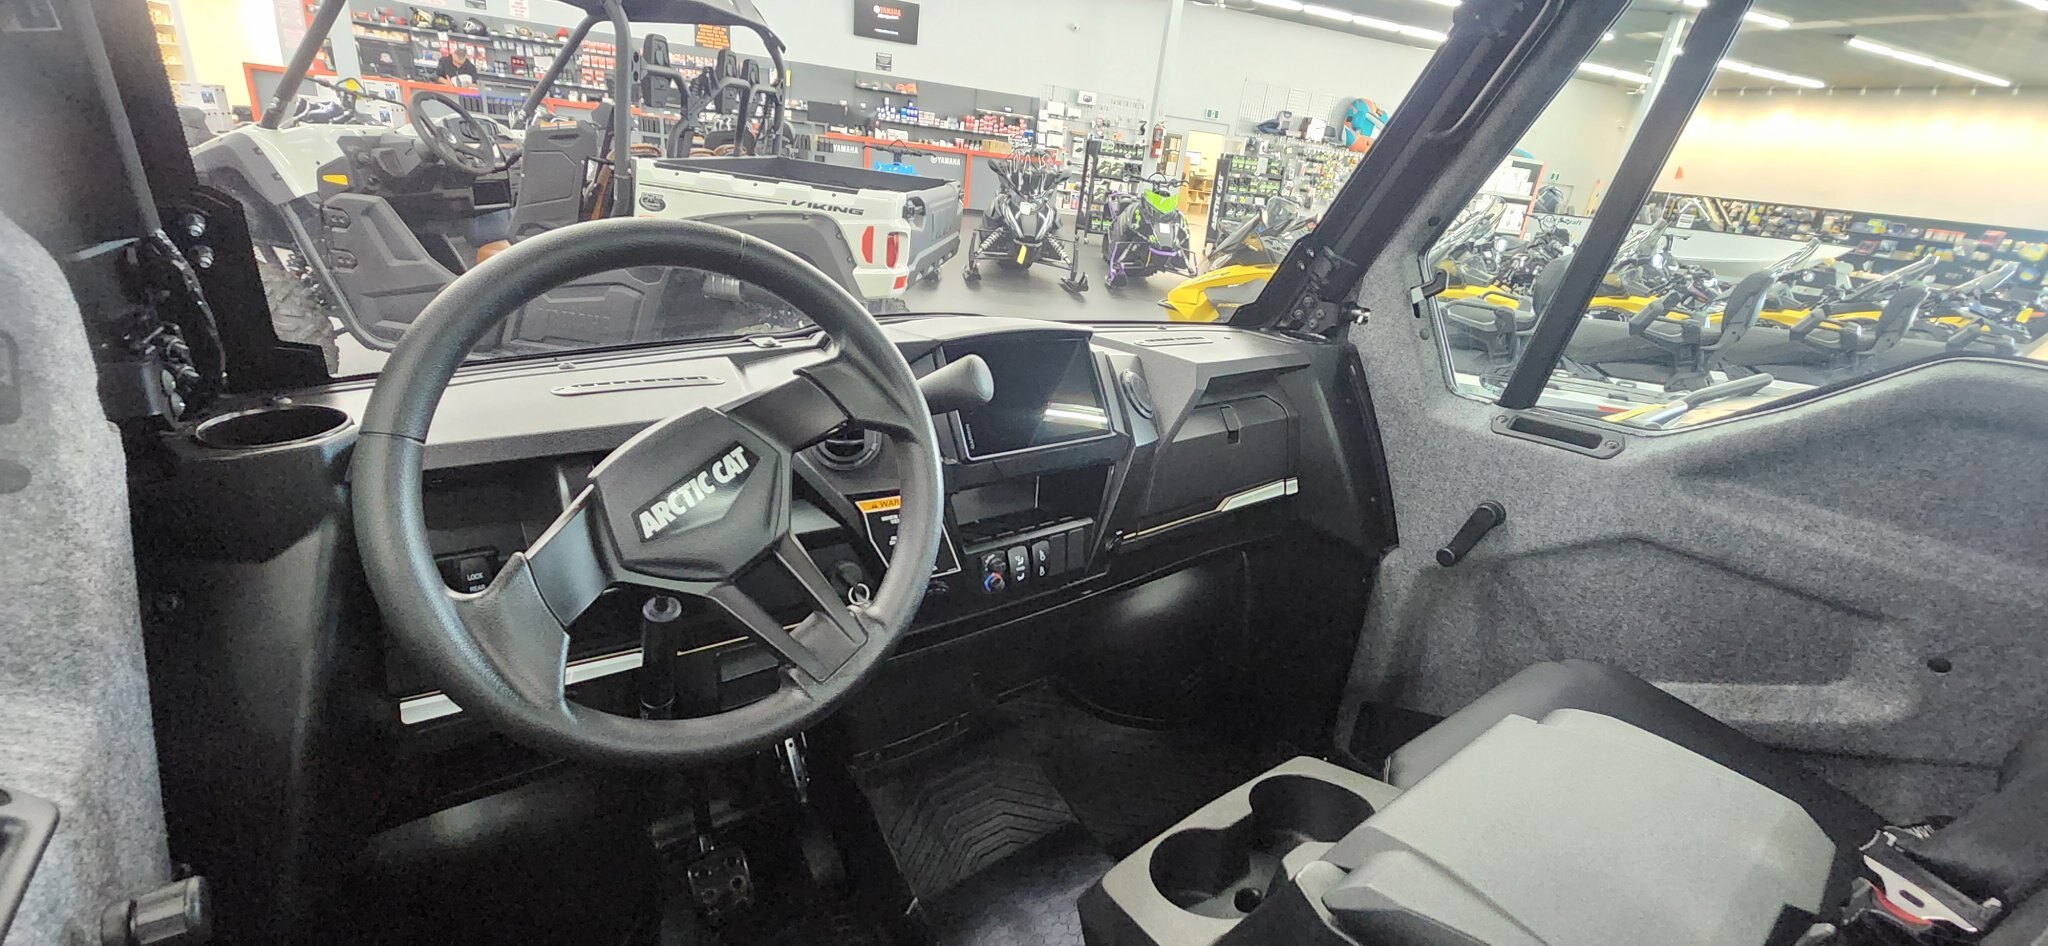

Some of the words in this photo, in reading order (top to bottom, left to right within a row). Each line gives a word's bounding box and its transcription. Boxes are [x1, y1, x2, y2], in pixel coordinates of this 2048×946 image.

[833, 144, 859, 154] YAMAHA
[937, 156, 961, 167] YAMAHA
[1216, 171, 1225, 194] CAT
[791, 200, 864, 216] VIKING
[1211, 193, 1222, 231] ARCTIC
[639, 470, 716, 539] ARCTIC
[711, 445, 749, 484] CAT
[466, 571, 484, 582] LOCK
